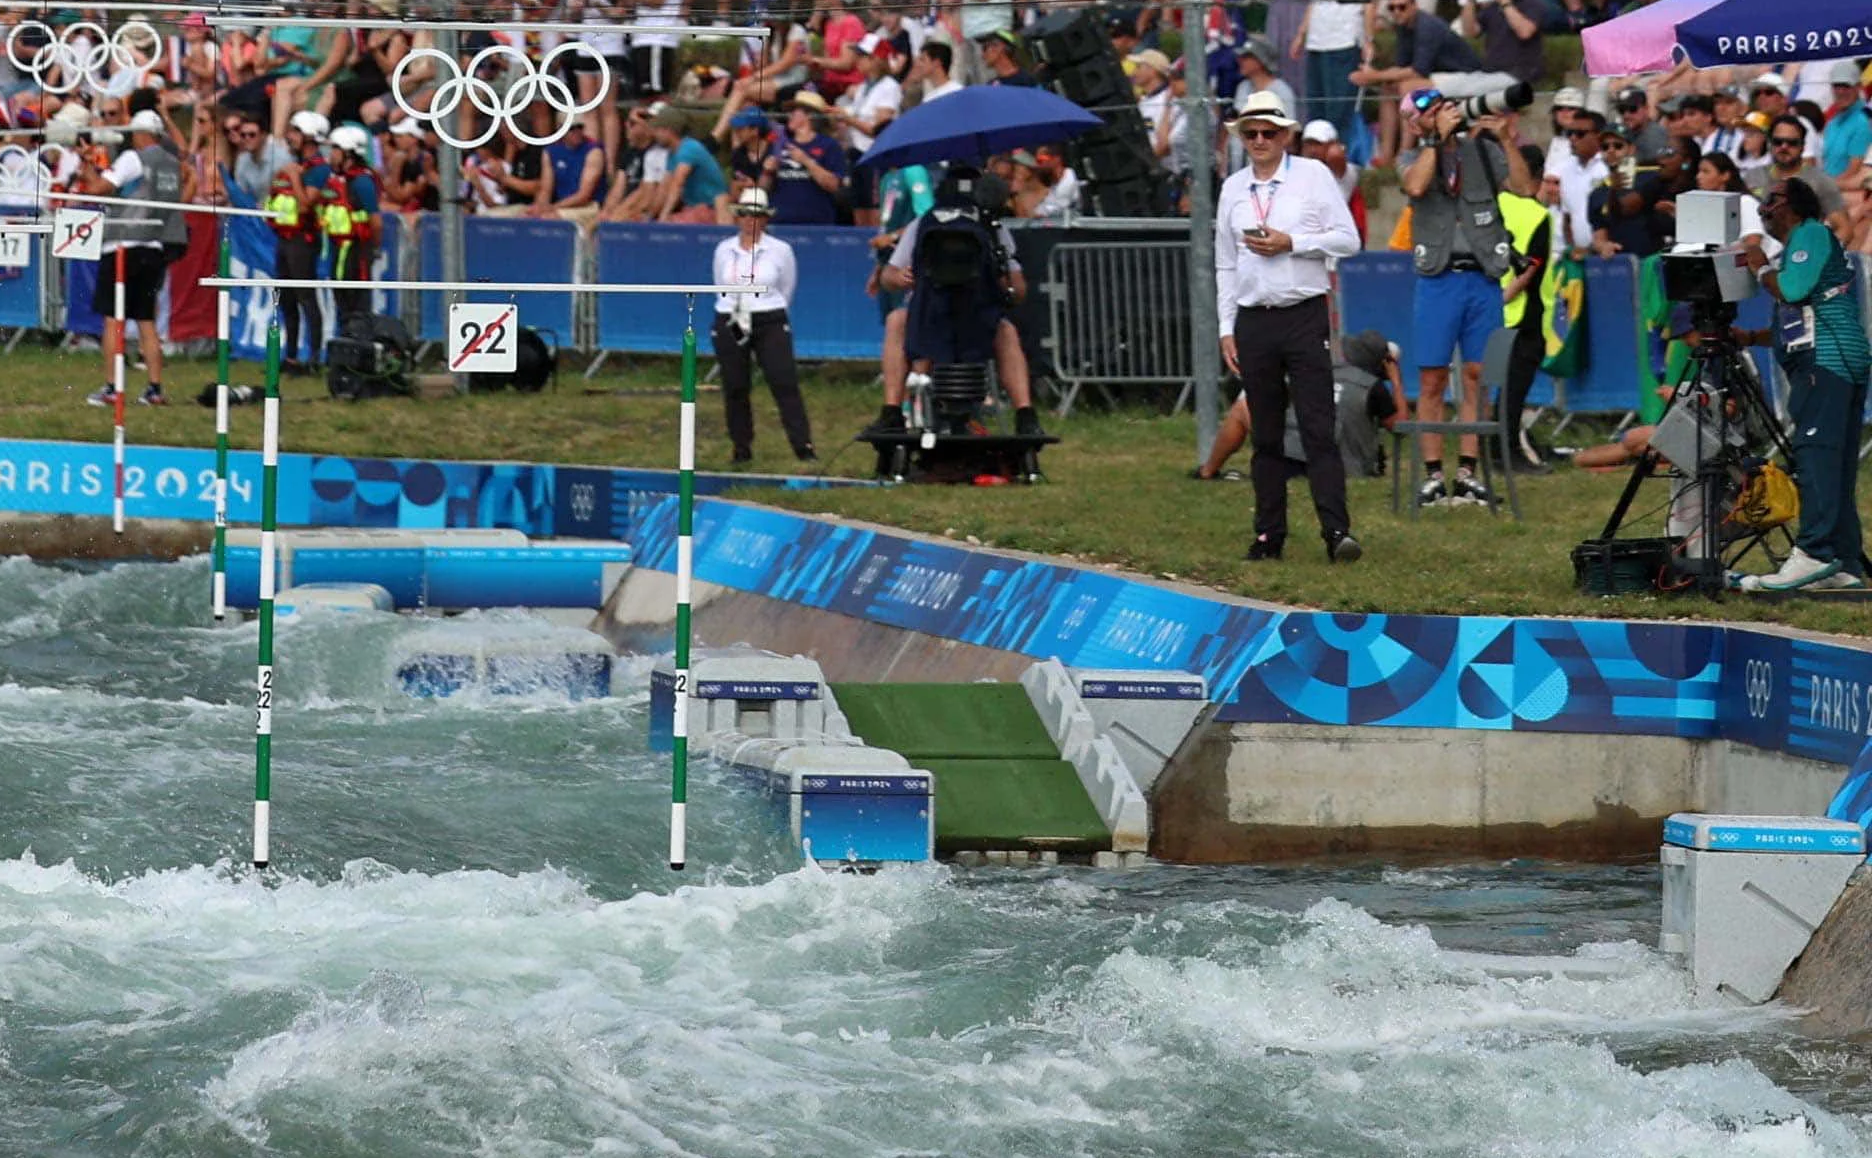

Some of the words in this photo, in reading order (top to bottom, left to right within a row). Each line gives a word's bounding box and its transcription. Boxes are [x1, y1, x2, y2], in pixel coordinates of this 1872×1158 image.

[65, 223, 92, 246] 19
[2, 238, 19, 256] 17
[460, 322, 506, 354] 22
[124, 466, 252, 503] 2024
[264, 671, 272, 689] 2
